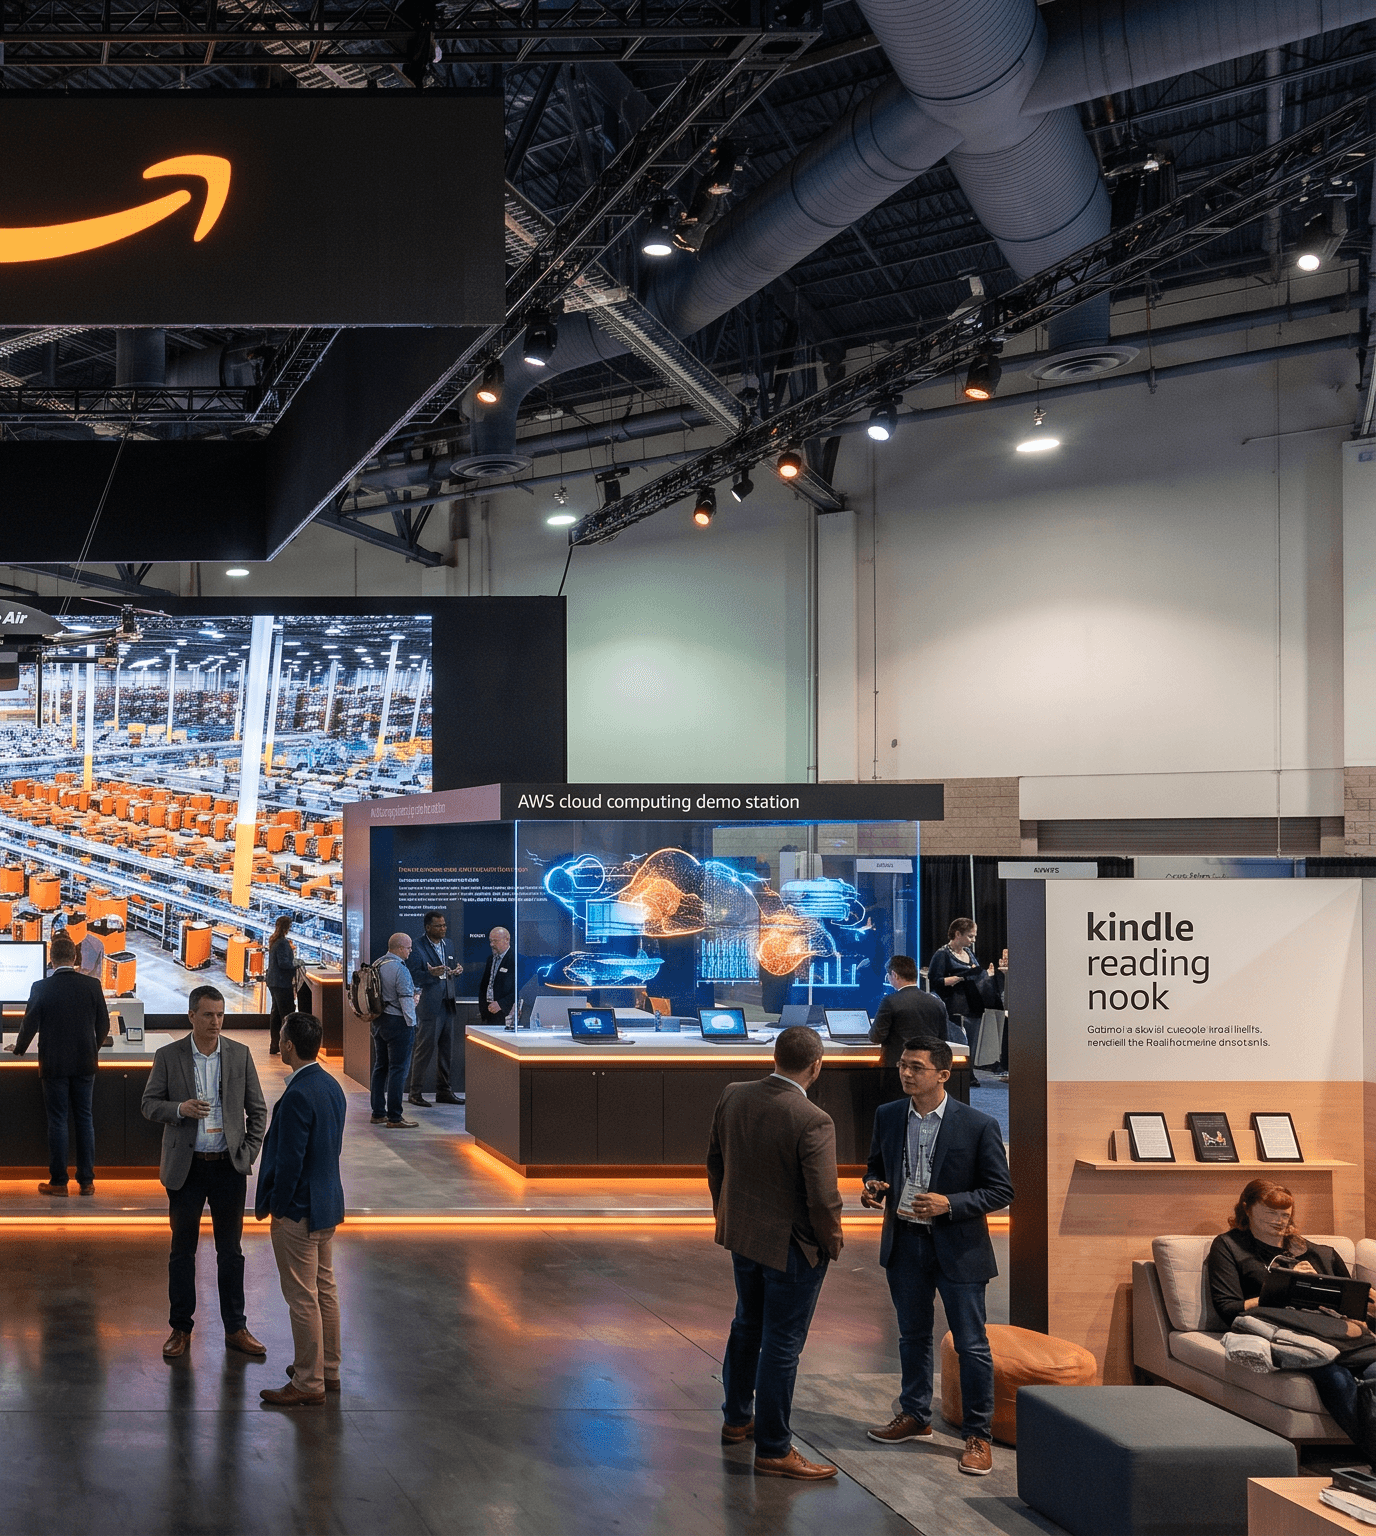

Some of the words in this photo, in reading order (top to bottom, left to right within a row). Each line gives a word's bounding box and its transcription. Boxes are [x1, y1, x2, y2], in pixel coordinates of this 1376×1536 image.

[2, 611, 28, 625] Air
[517, 794, 554, 809] AWS
[560, 794, 602, 809] cloud
[607, 794, 691, 813] computing
[697, 794, 741, 809] demo
[746, 794, 800, 809] station
[1087, 911, 1194, 942] kindle
[1087, 948, 1210, 984] reading
[1087, 981, 1170, 1011] nook
[1128, 1038, 1144, 1047] the
